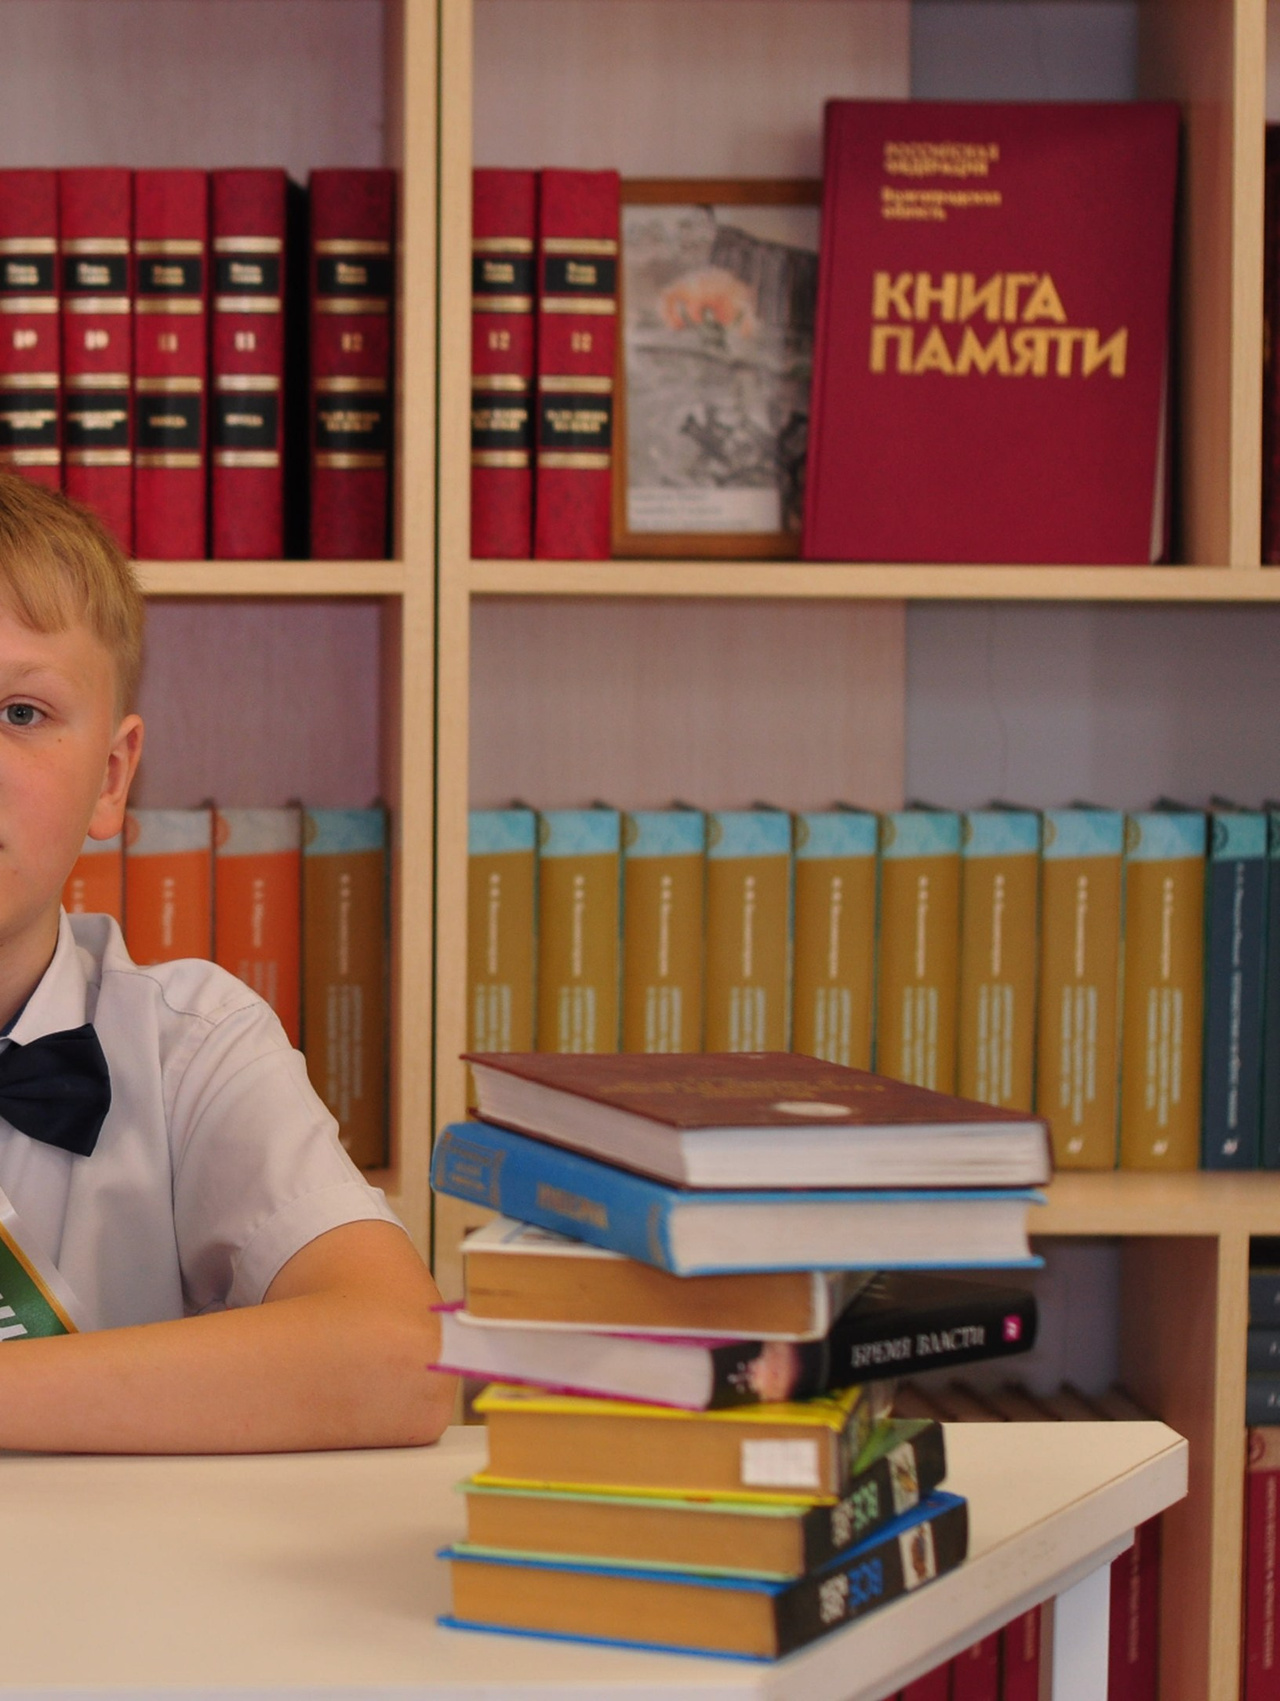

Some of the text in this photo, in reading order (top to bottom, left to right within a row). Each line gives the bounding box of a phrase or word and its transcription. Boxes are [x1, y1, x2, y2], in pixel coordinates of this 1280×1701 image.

[873, 271, 1067, 323] КНИГА
[869, 324, 1128, 378] ПАМЯТИ
[916, 1325, 986, 1356] ВЛАСТИ
